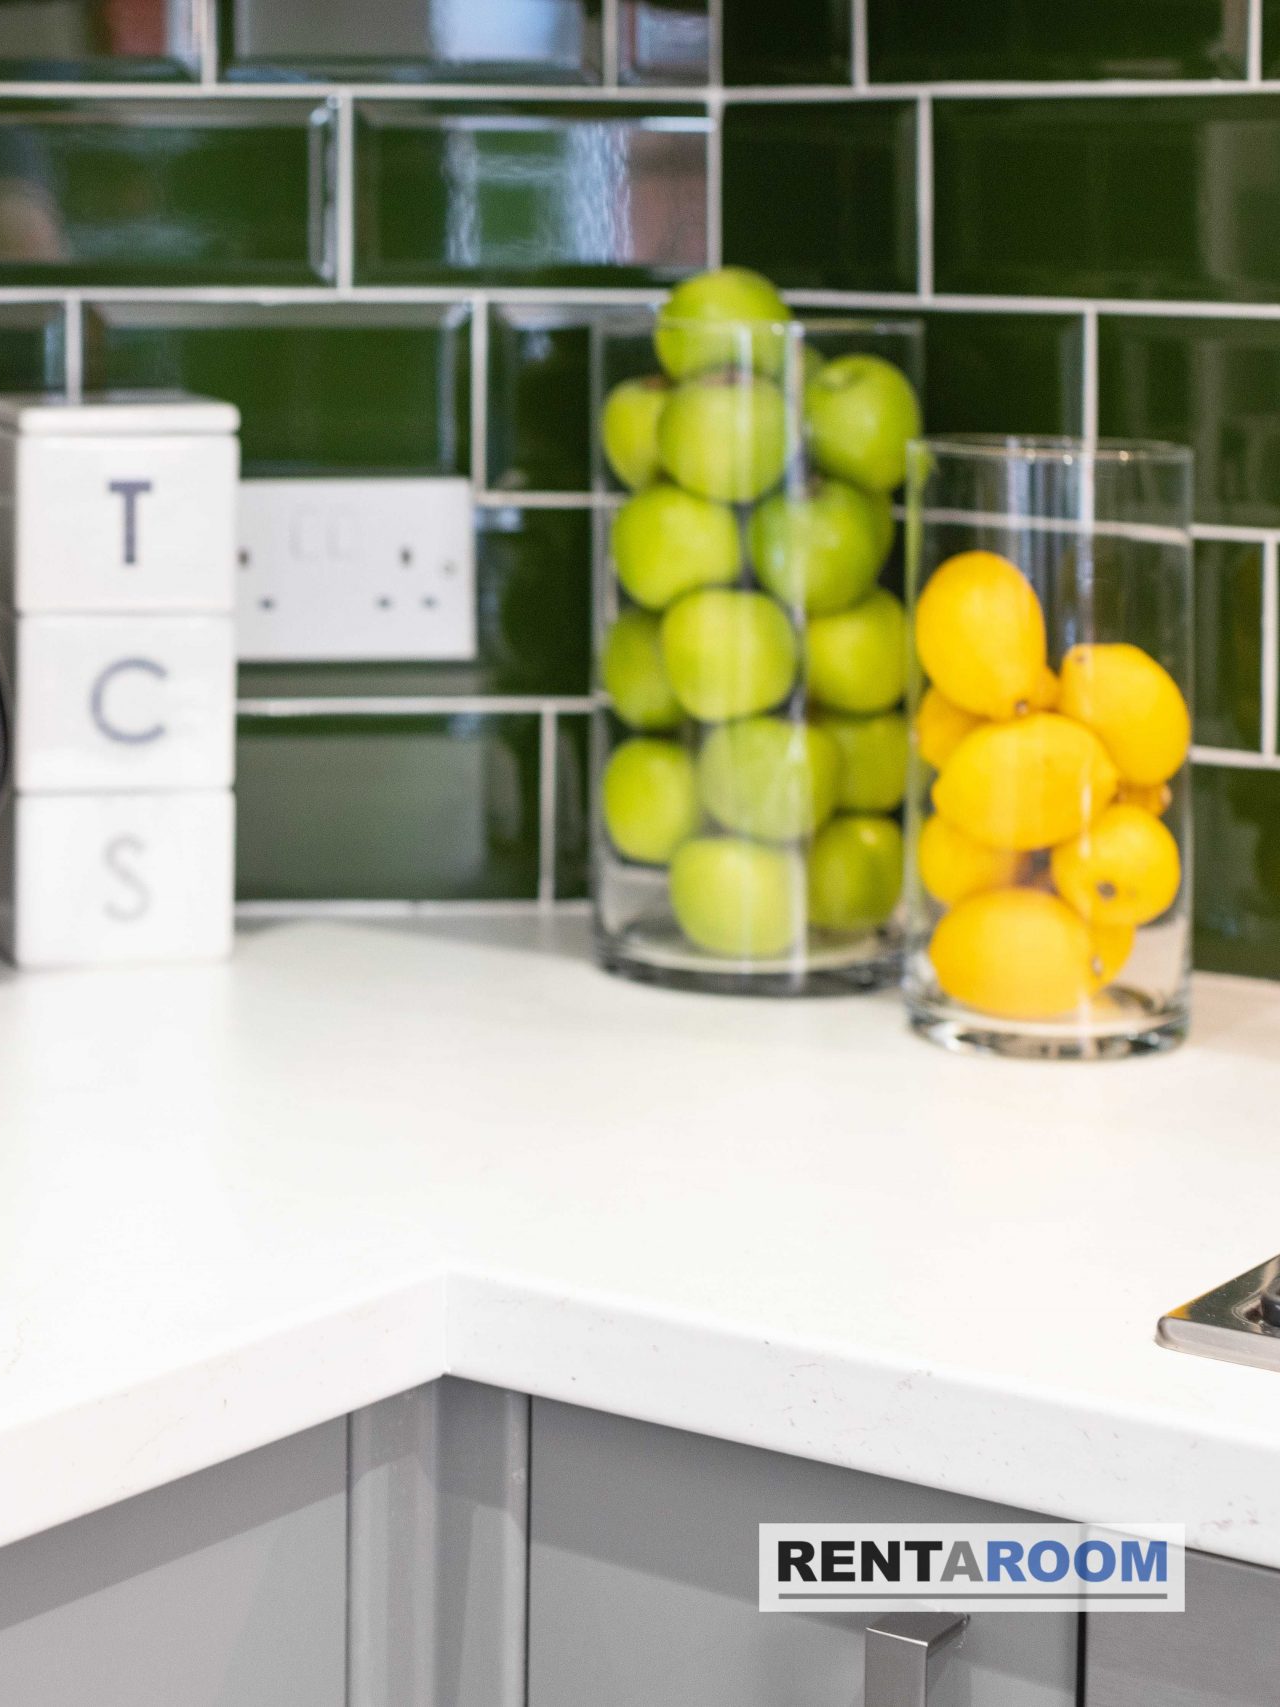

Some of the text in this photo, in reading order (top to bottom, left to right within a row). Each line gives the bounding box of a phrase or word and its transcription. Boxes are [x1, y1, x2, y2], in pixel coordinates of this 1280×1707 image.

[107, 480, 153, 566] T
[90, 657, 168, 746] C
[103, 833, 152, 923] S
